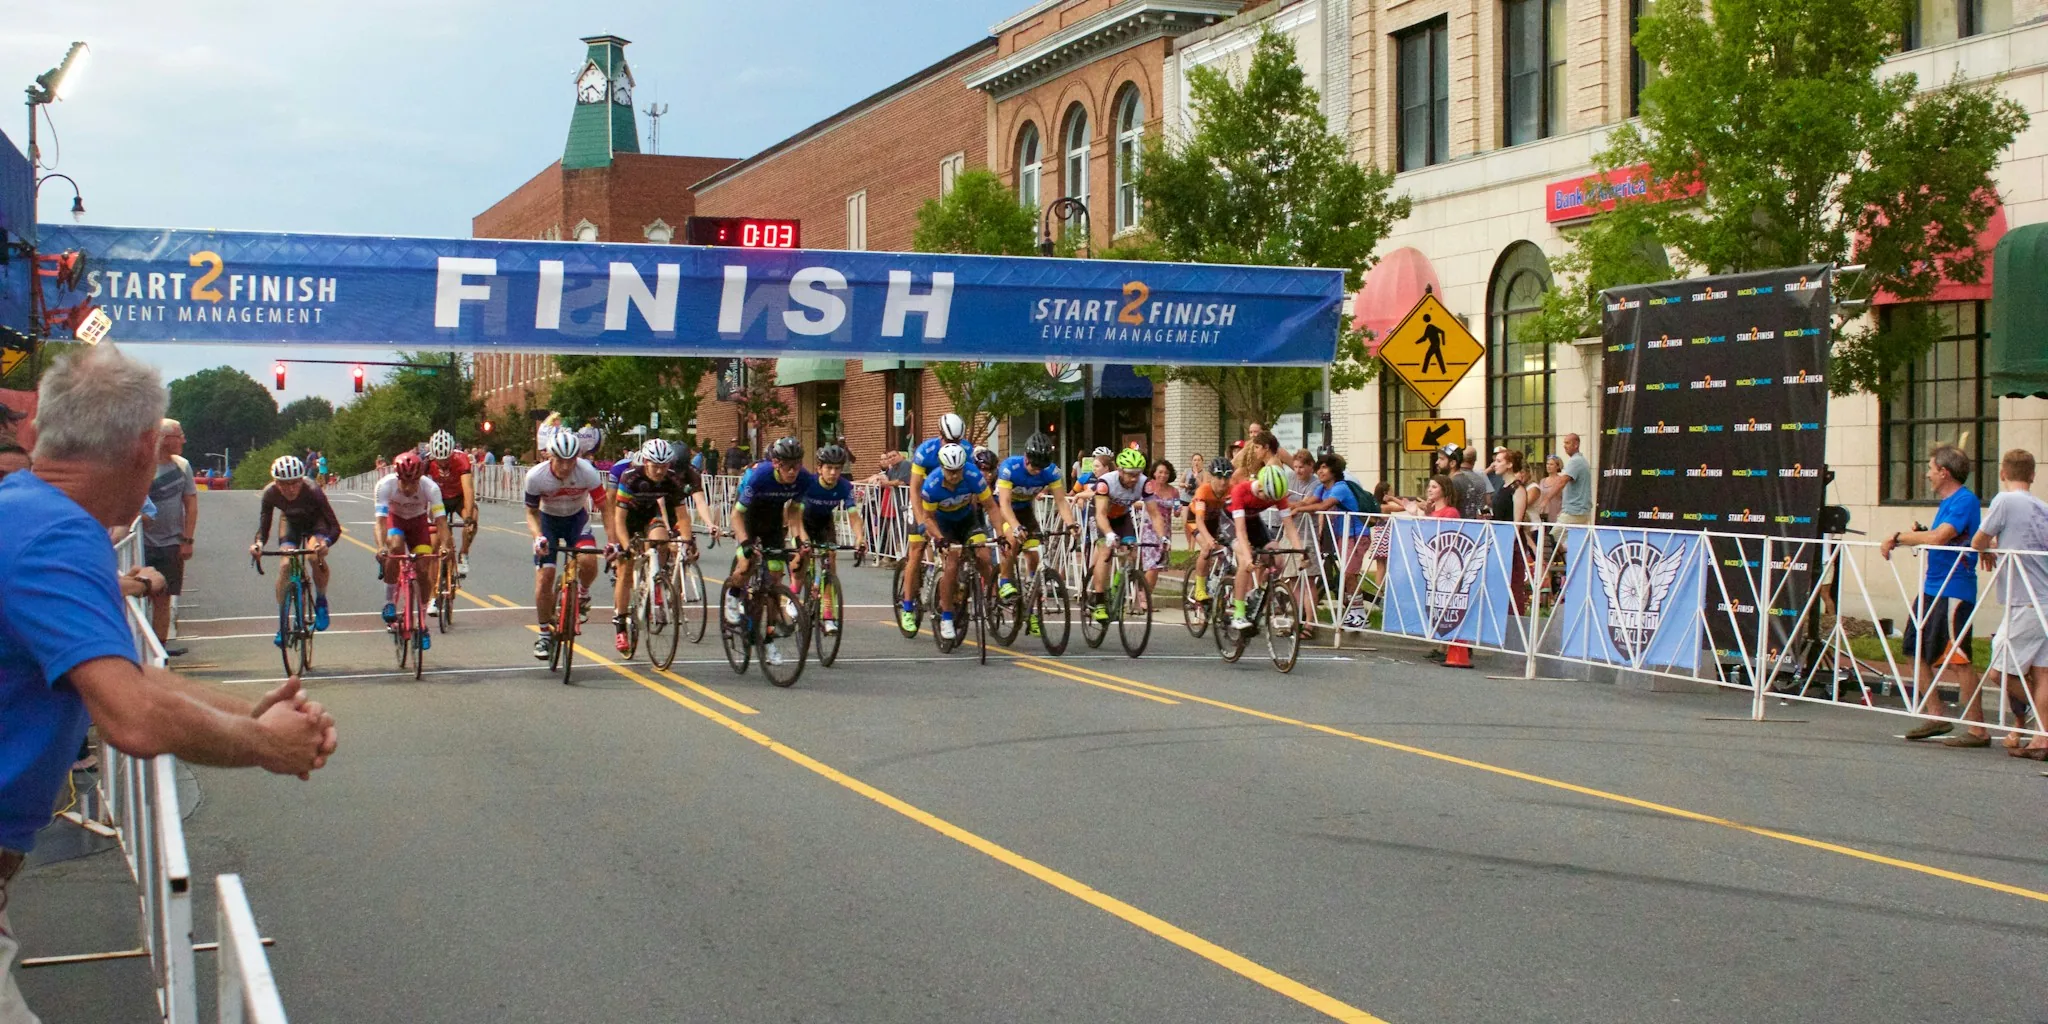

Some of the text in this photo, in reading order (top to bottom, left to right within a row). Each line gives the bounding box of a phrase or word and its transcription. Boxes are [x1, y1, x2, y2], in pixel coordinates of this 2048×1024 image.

[1555, 187, 1582, 210] Bank
[743, 224, 792, 247] 0:03
[434, 256, 955, 338] FINISH
[101, 304, 323, 324] EVENT MANAGEMENT
[1042, 324, 1221, 344] EVENT MANAGEMENT
